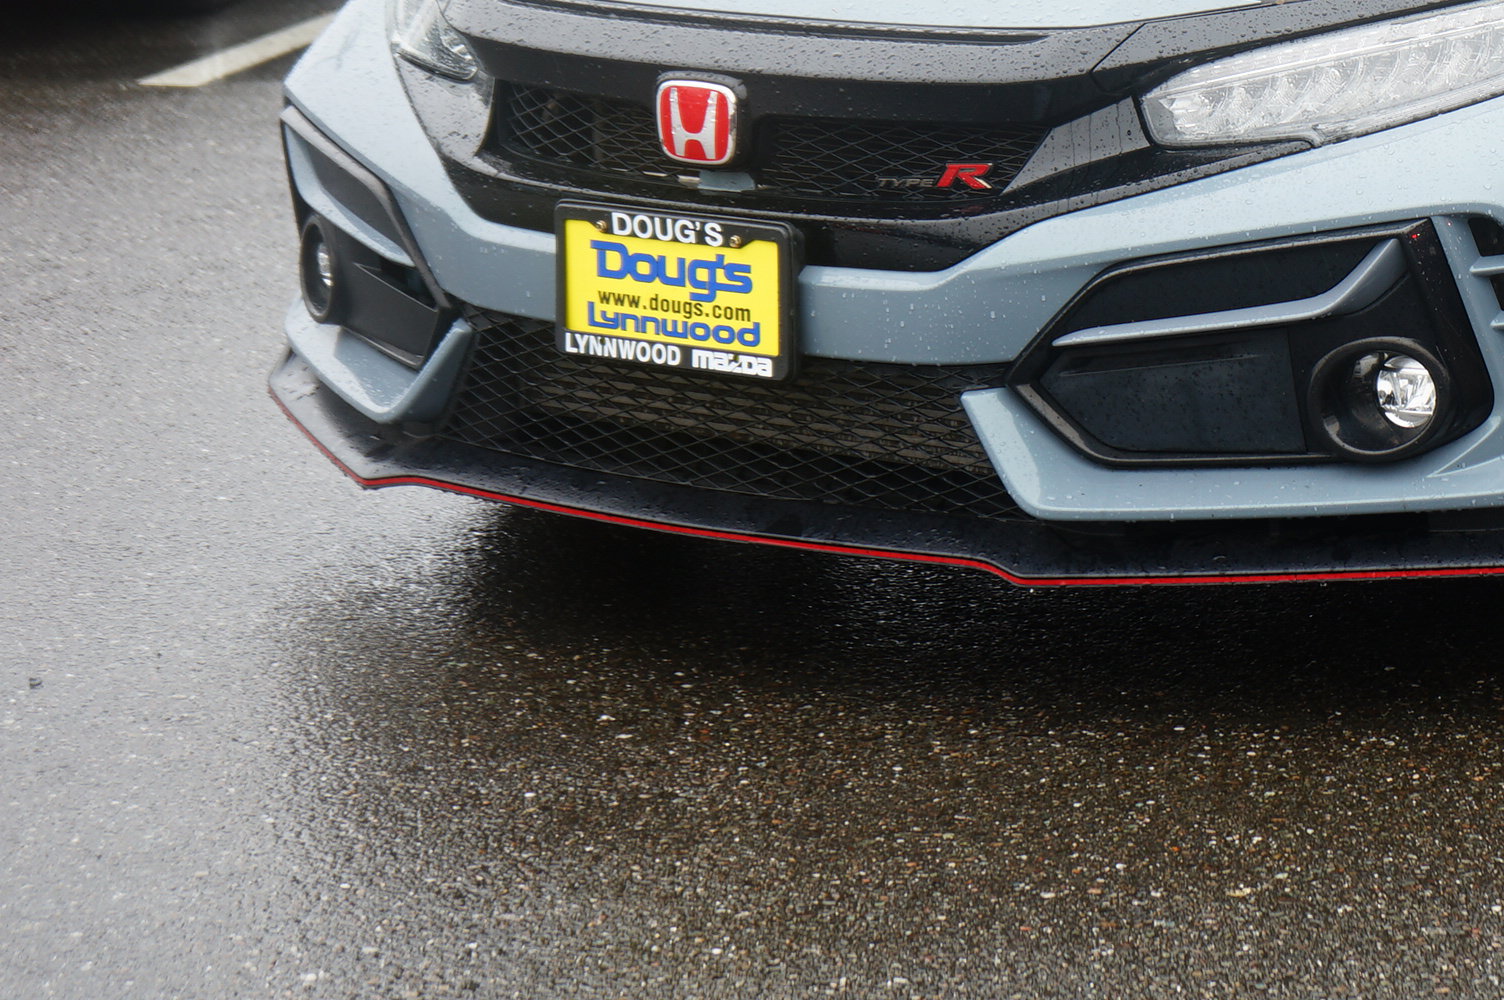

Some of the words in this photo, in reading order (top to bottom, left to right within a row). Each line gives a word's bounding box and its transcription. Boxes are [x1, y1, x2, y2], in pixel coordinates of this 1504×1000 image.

[877, 177, 936, 189] TYPE
[936, 163, 993, 190] R
[610, 212, 724, 248] DOUG'S
[590, 239, 753, 303] Doug's
[597, 290, 752, 323] www.dougs.com
[587, 301, 761, 348] Lynnwood
[564, 332, 681, 367] LYNNWOOD
